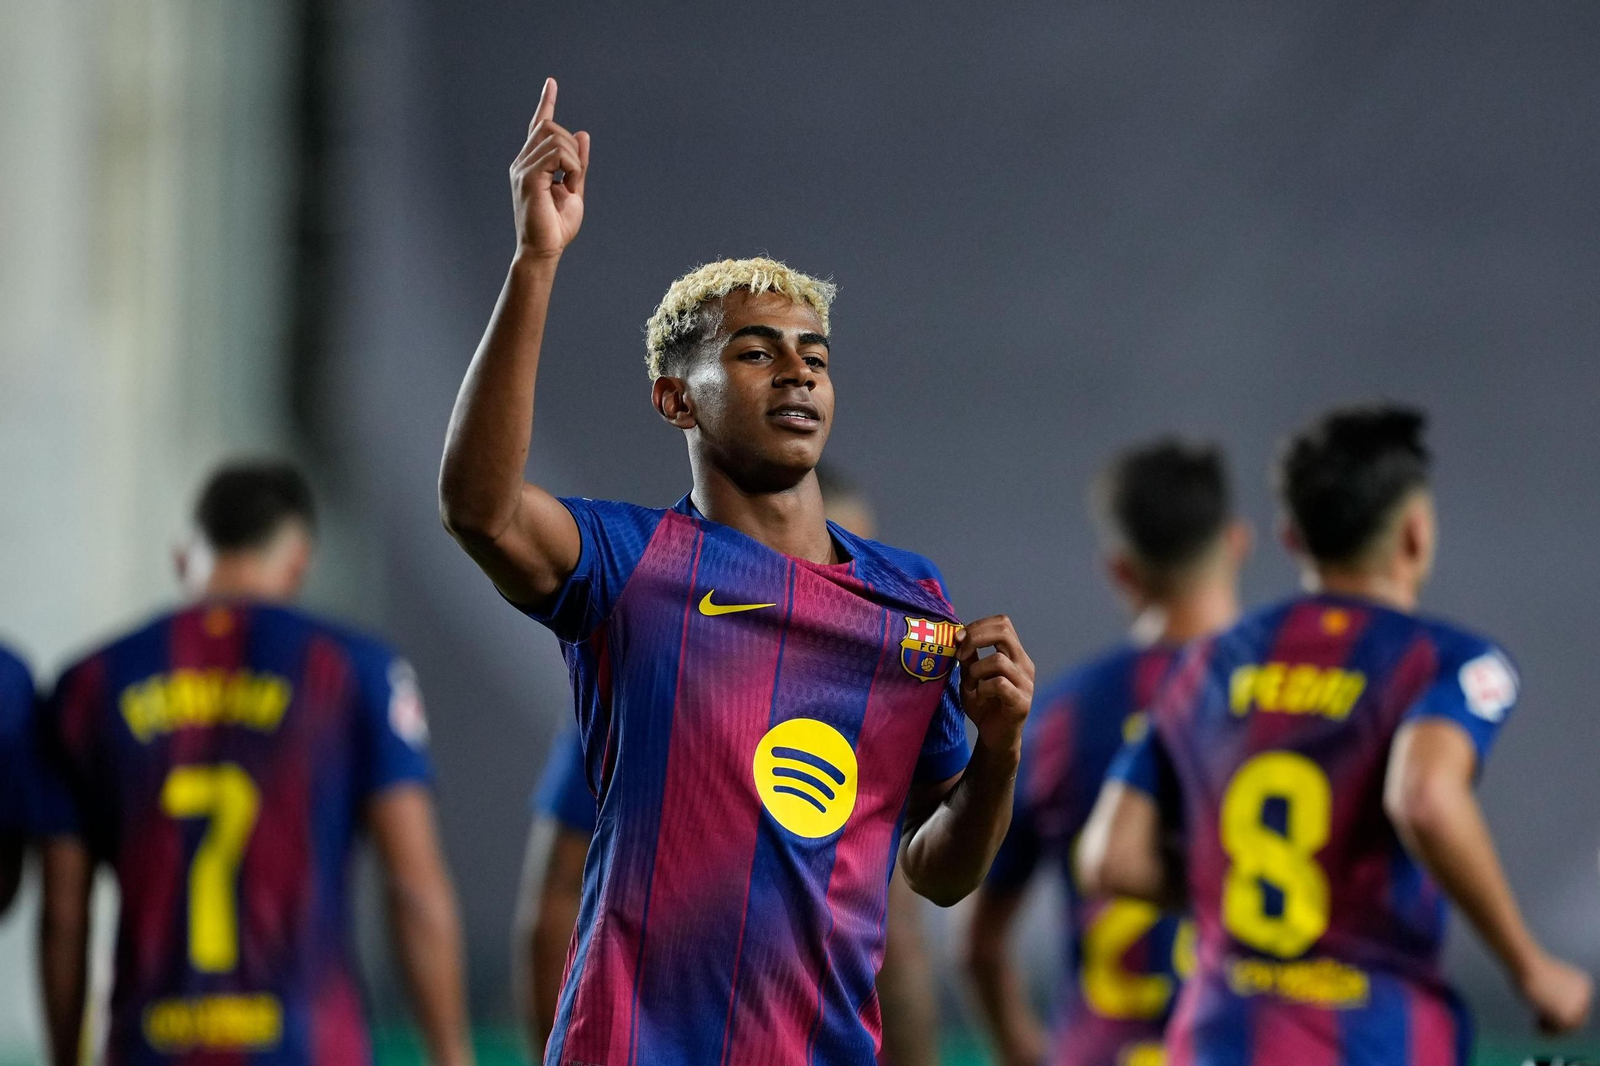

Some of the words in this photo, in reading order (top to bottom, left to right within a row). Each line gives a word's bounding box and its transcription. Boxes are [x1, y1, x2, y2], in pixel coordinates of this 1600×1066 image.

[920, 642, 944, 654] FCB
[163, 764, 260, 972] 7
[1221, 751, 1332, 957] 8
